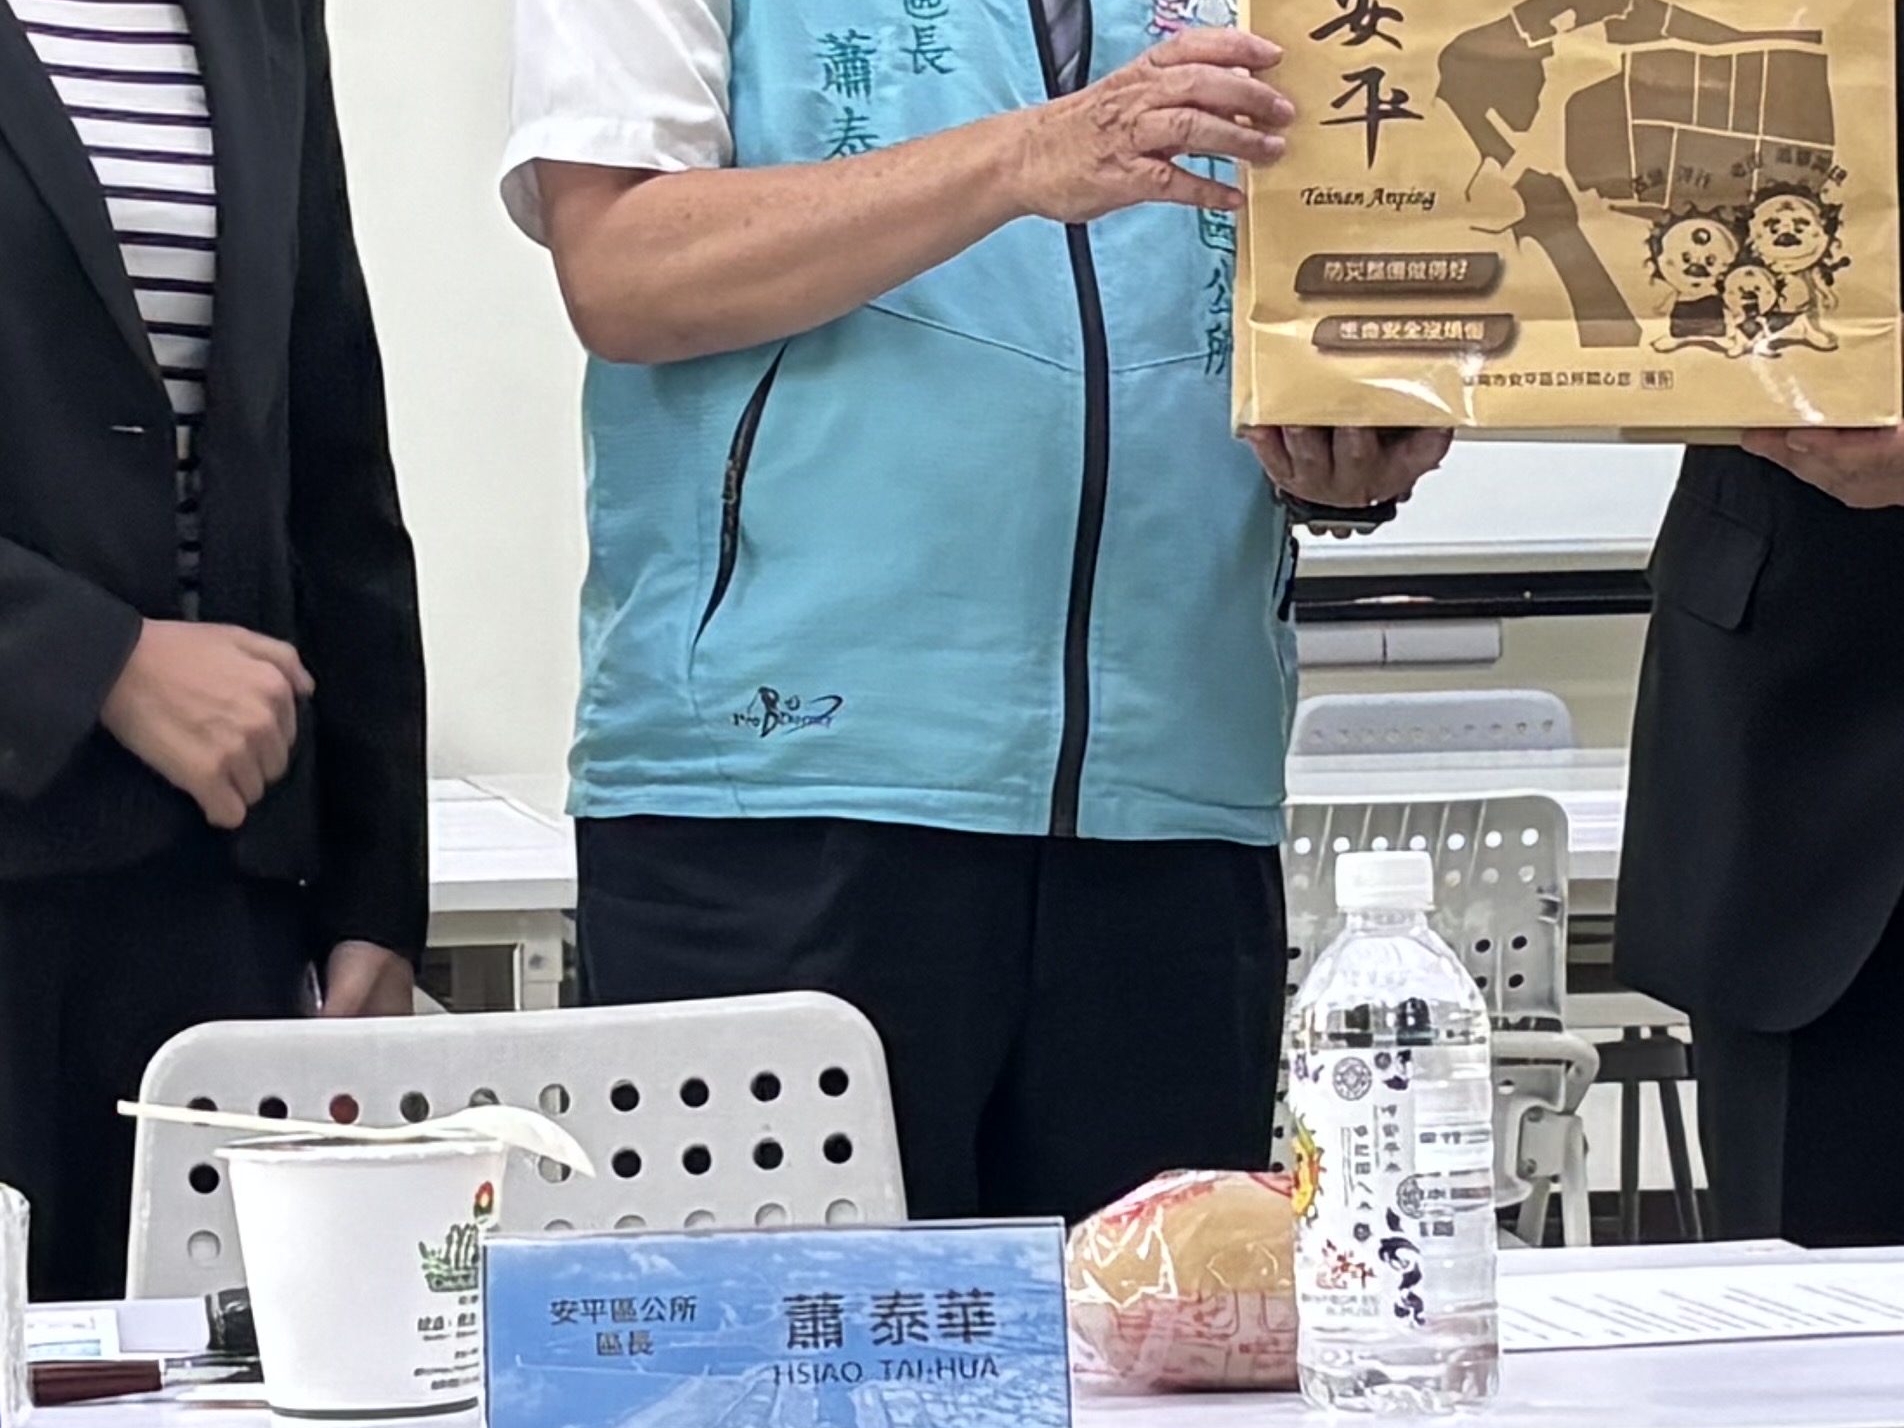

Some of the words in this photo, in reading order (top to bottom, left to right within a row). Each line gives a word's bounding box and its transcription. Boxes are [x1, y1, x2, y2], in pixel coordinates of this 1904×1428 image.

[1300, 187, 1365, 207] Tainan
[1366, 187, 1437, 211] Anping
[549, 1295, 697, 1325] 安平區公所
[868, 1287, 997, 1346] 泰華
[596, 1329, 654, 1356] 區長
[772, 1360, 864, 1385] HSIAO
[879, 1355, 1000, 1382] TAI-HUA
